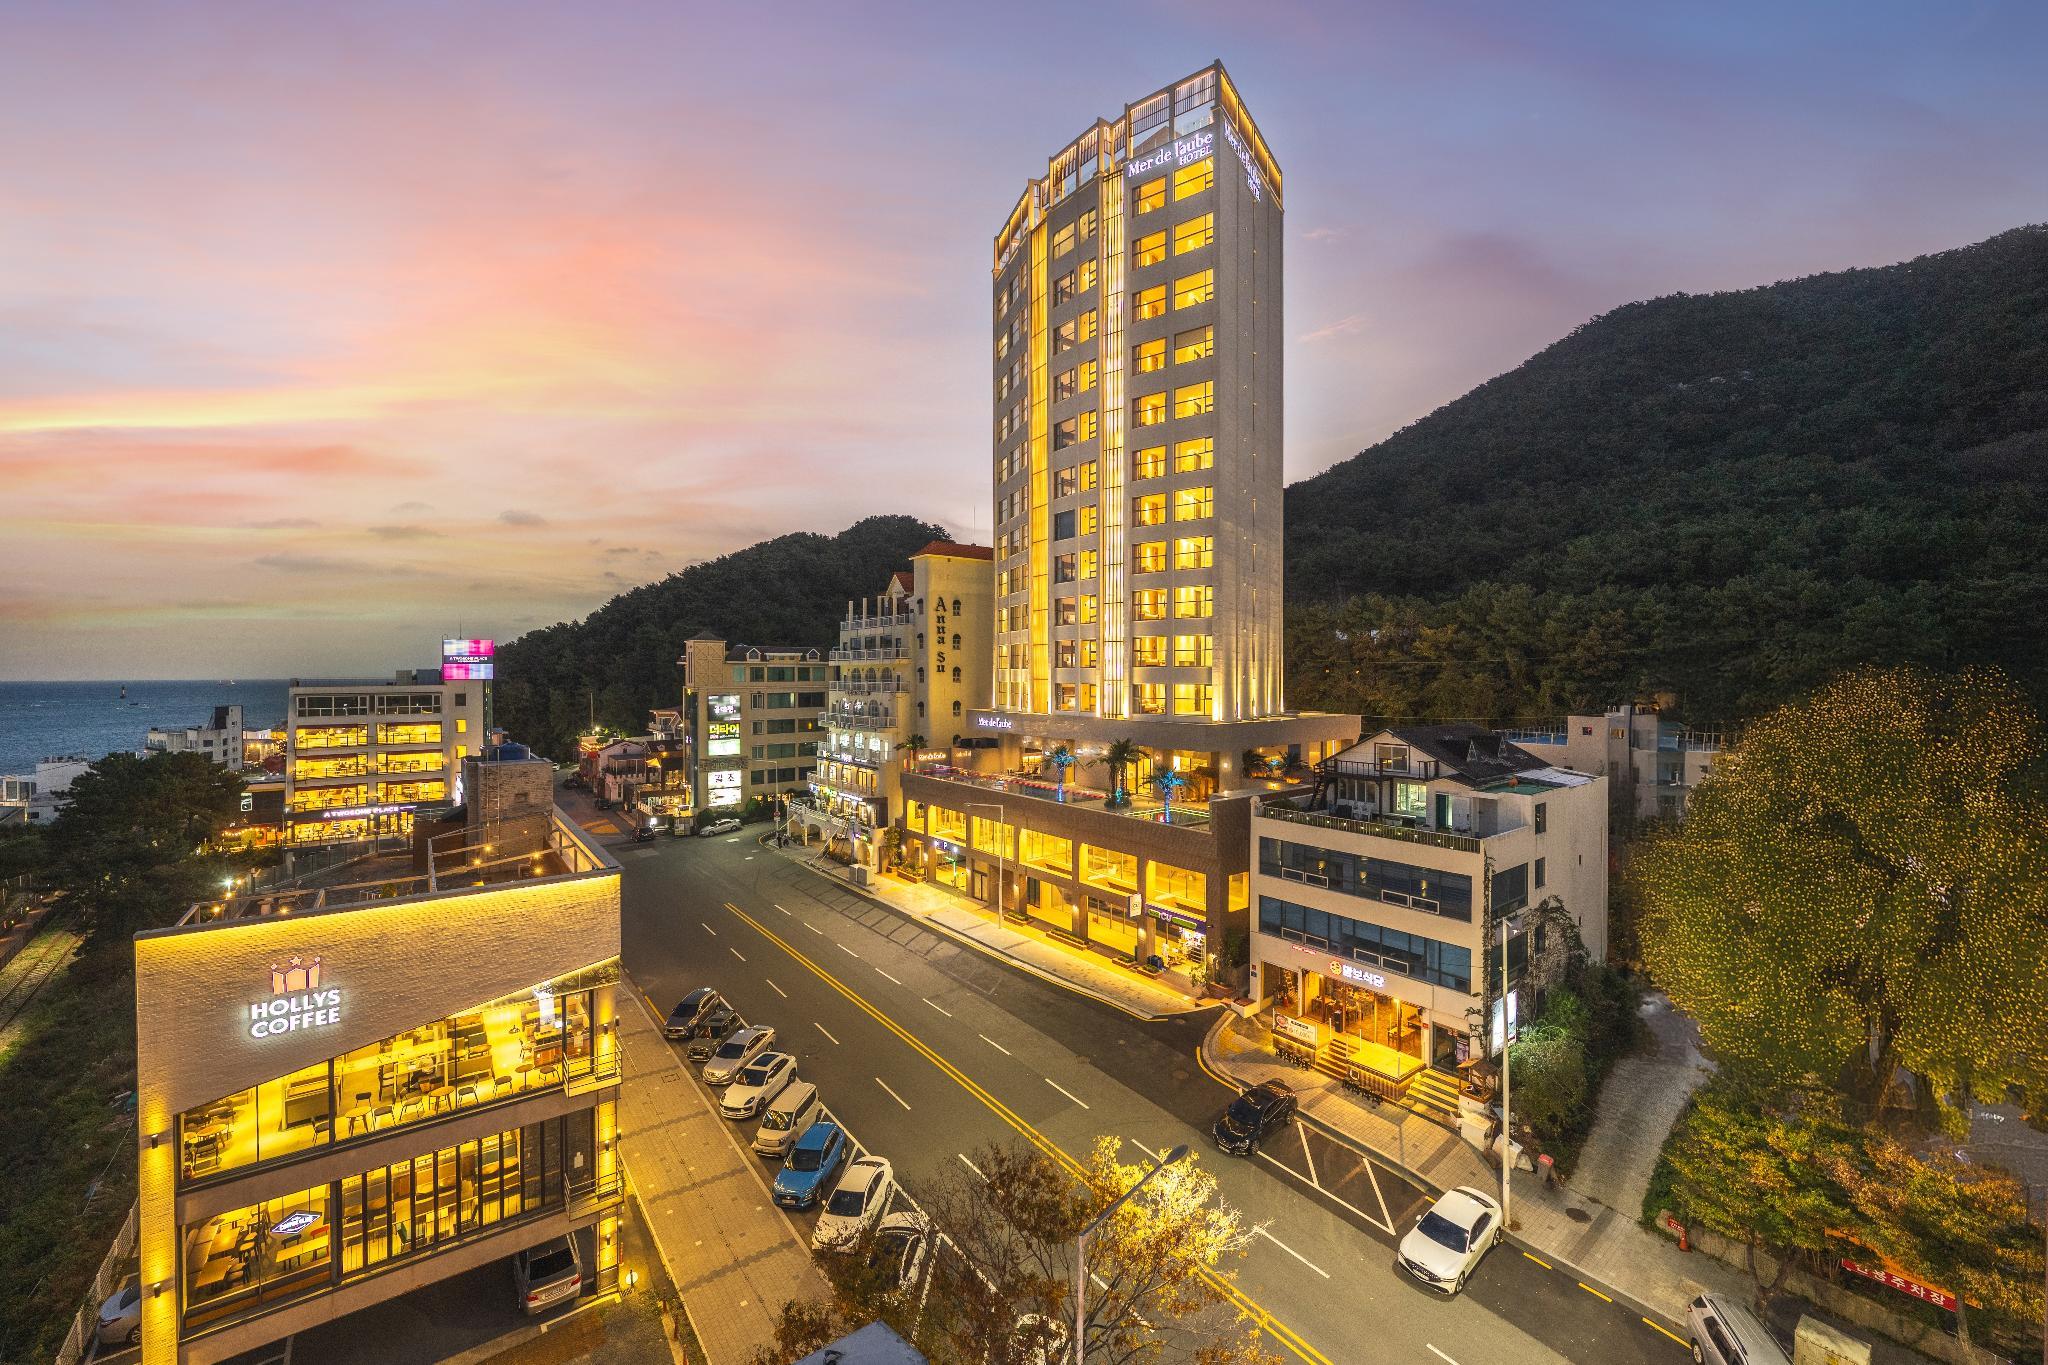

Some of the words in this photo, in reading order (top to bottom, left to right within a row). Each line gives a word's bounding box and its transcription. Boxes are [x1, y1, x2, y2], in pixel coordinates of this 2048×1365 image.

[1128, 158, 1154, 178] Mer
[1155, 148, 1172, 165] de
[1179, 145, 1214, 166] HOTEL
[709, 723, 740, 735] 더타이
[331, 808, 372, 818] TWOSOME
[373, 806, 399, 815] PLACE
[1160, 911, 1173, 923] CU
[251, 989, 341, 1020] HOLLYS
[251, 1006, 341, 1038] COFFEE
